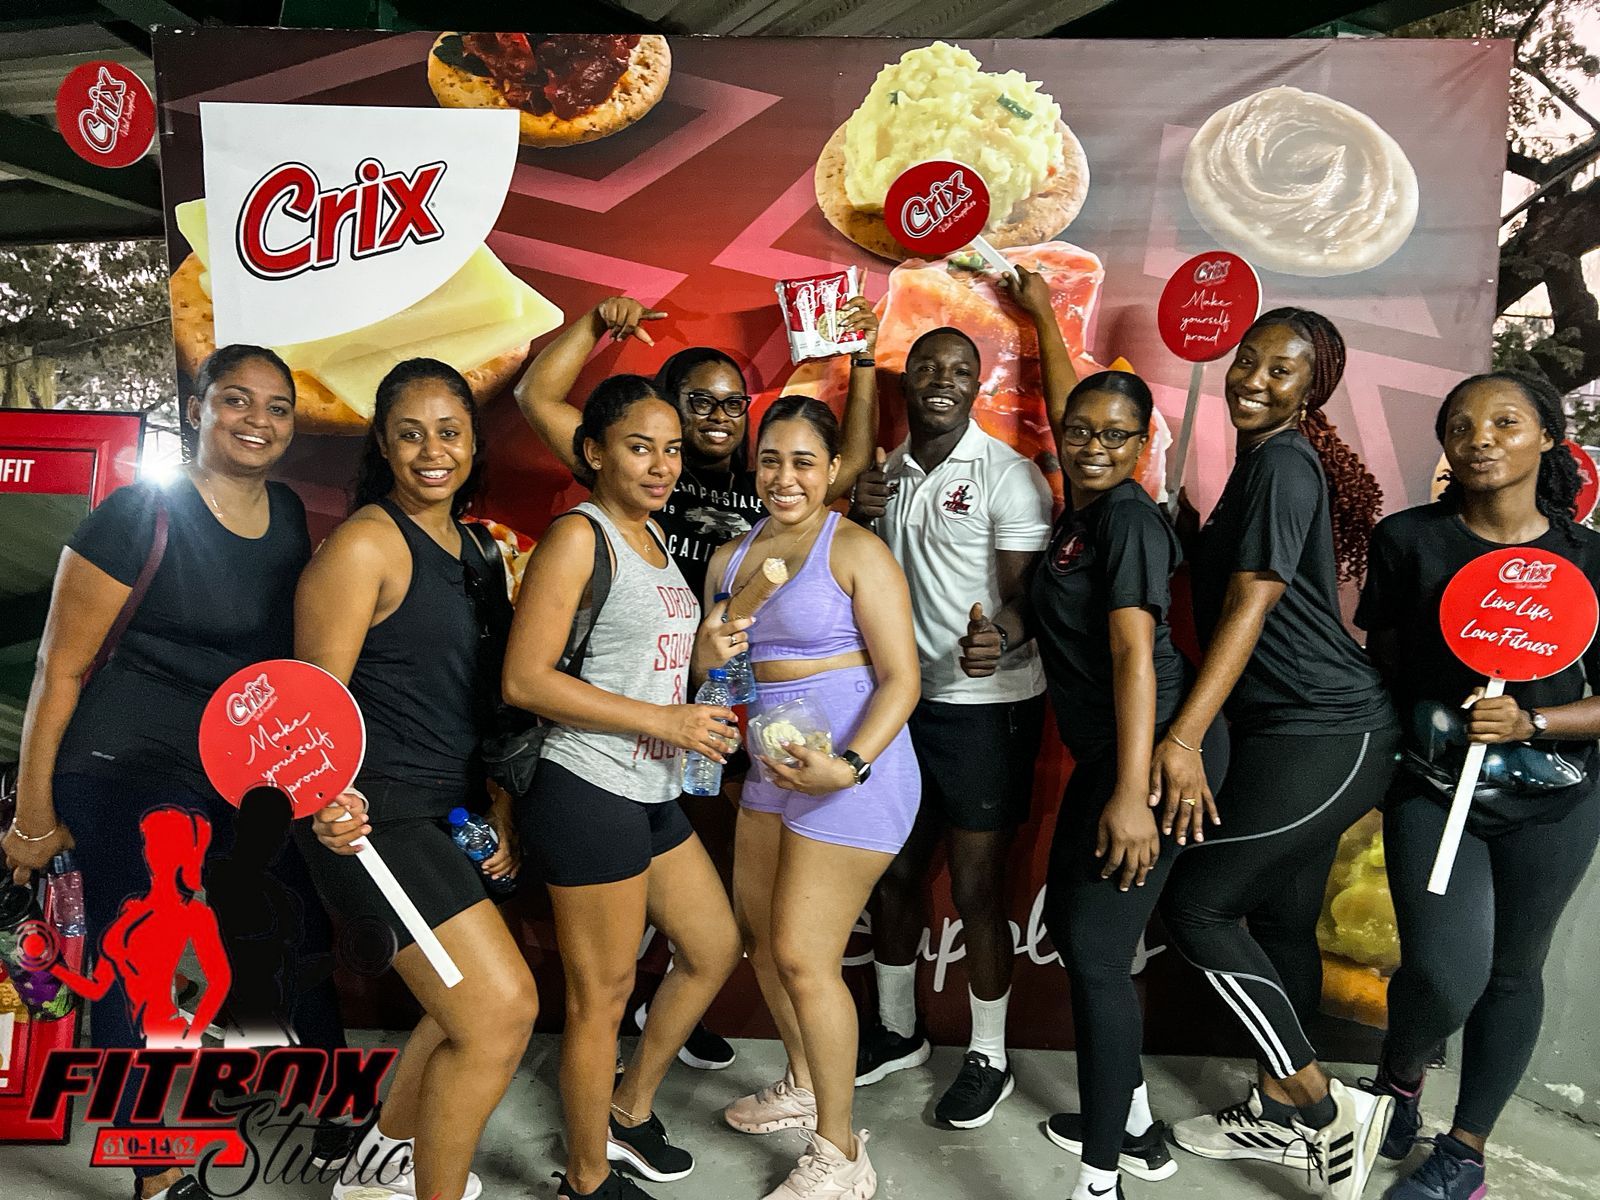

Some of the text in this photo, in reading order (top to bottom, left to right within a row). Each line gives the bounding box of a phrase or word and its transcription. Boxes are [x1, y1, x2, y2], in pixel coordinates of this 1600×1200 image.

[79, 67, 126, 153] Crix
[235, 157, 448, 281] Crix
[901, 170, 972, 239] Crix
[1193, 261, 1231, 284] Crix
[1181, 288, 1233, 311] Make
[1179, 309, 1231, 333] yourself
[1183, 327, 1220, 348] proud
[0, 458, 36, 483] FIT
[1498, 558, 1557, 584] Crix
[1480, 588, 1554, 621] Live Life,
[1459, 618, 1559, 657] Love Fitness
[225, 672, 276, 727] Crix
[245, 711, 312, 766] Make
[261, 726, 336, 788] yourself
[284, 748, 338, 804] proud
